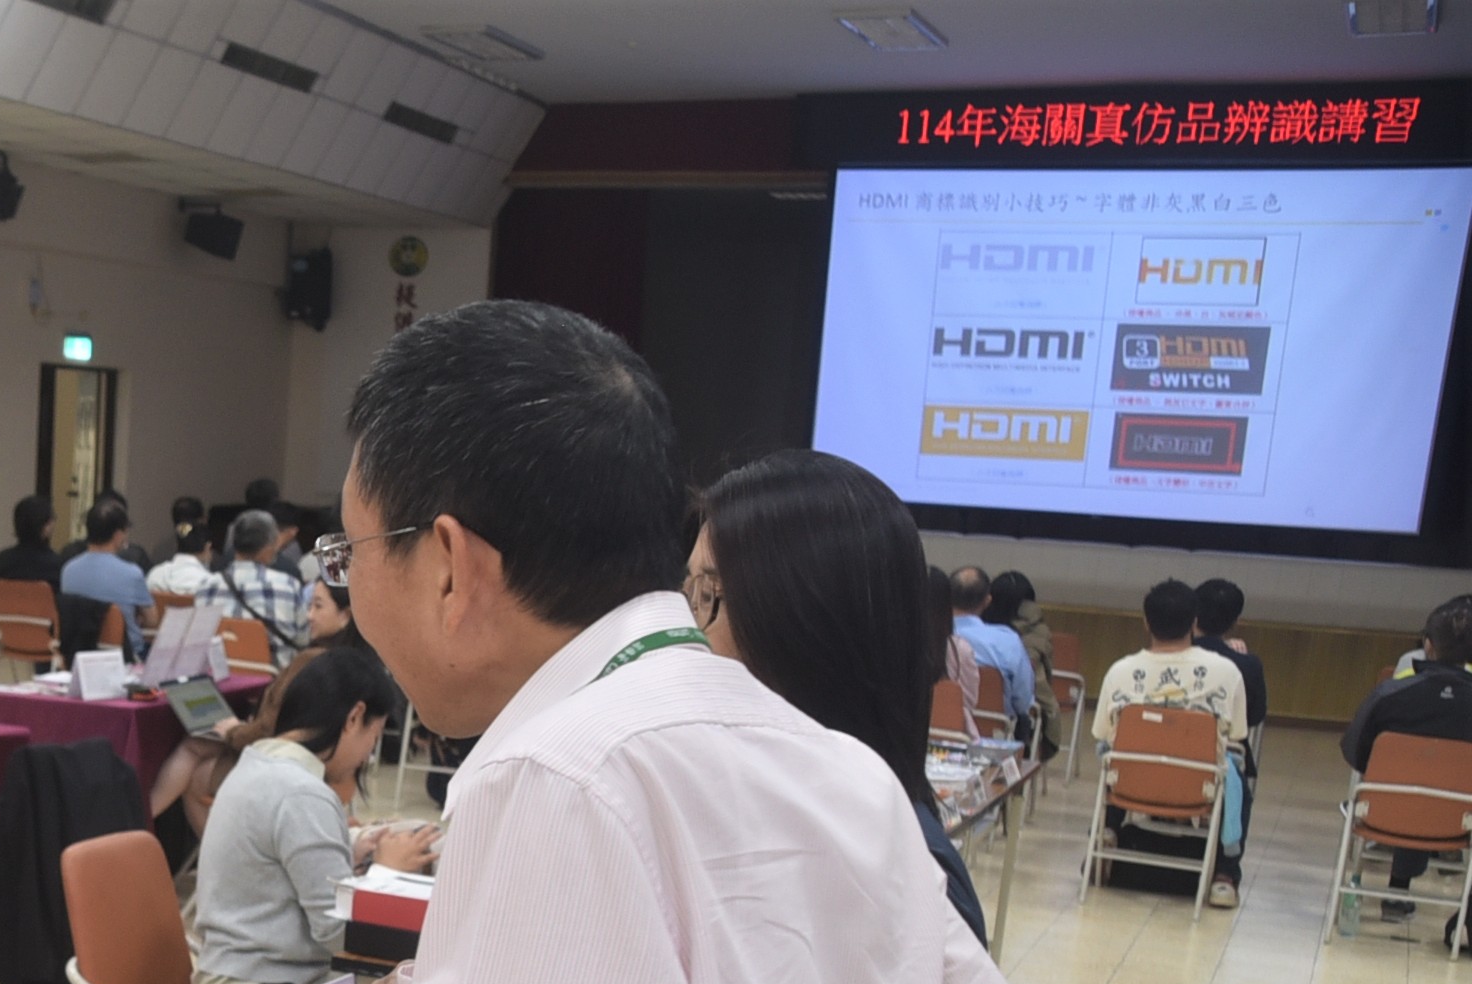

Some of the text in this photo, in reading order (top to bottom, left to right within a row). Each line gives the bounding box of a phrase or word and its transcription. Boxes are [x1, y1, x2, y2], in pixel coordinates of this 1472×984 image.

[897, 97, 1421, 147] 114年海關真仿品辨識講習
[858, 192, 909, 211] HDMI
[940, 243, 1095, 273] HDMI
[1138, 257, 1263, 286] HDMI
[932, 327, 1086, 360] HDMI
[1135, 339, 1149, 357] 3
[1159, 335, 1248, 357] HDMI
[1148, 372, 1231, 389] SWITCH
[931, 411, 1072, 444] HDMI
